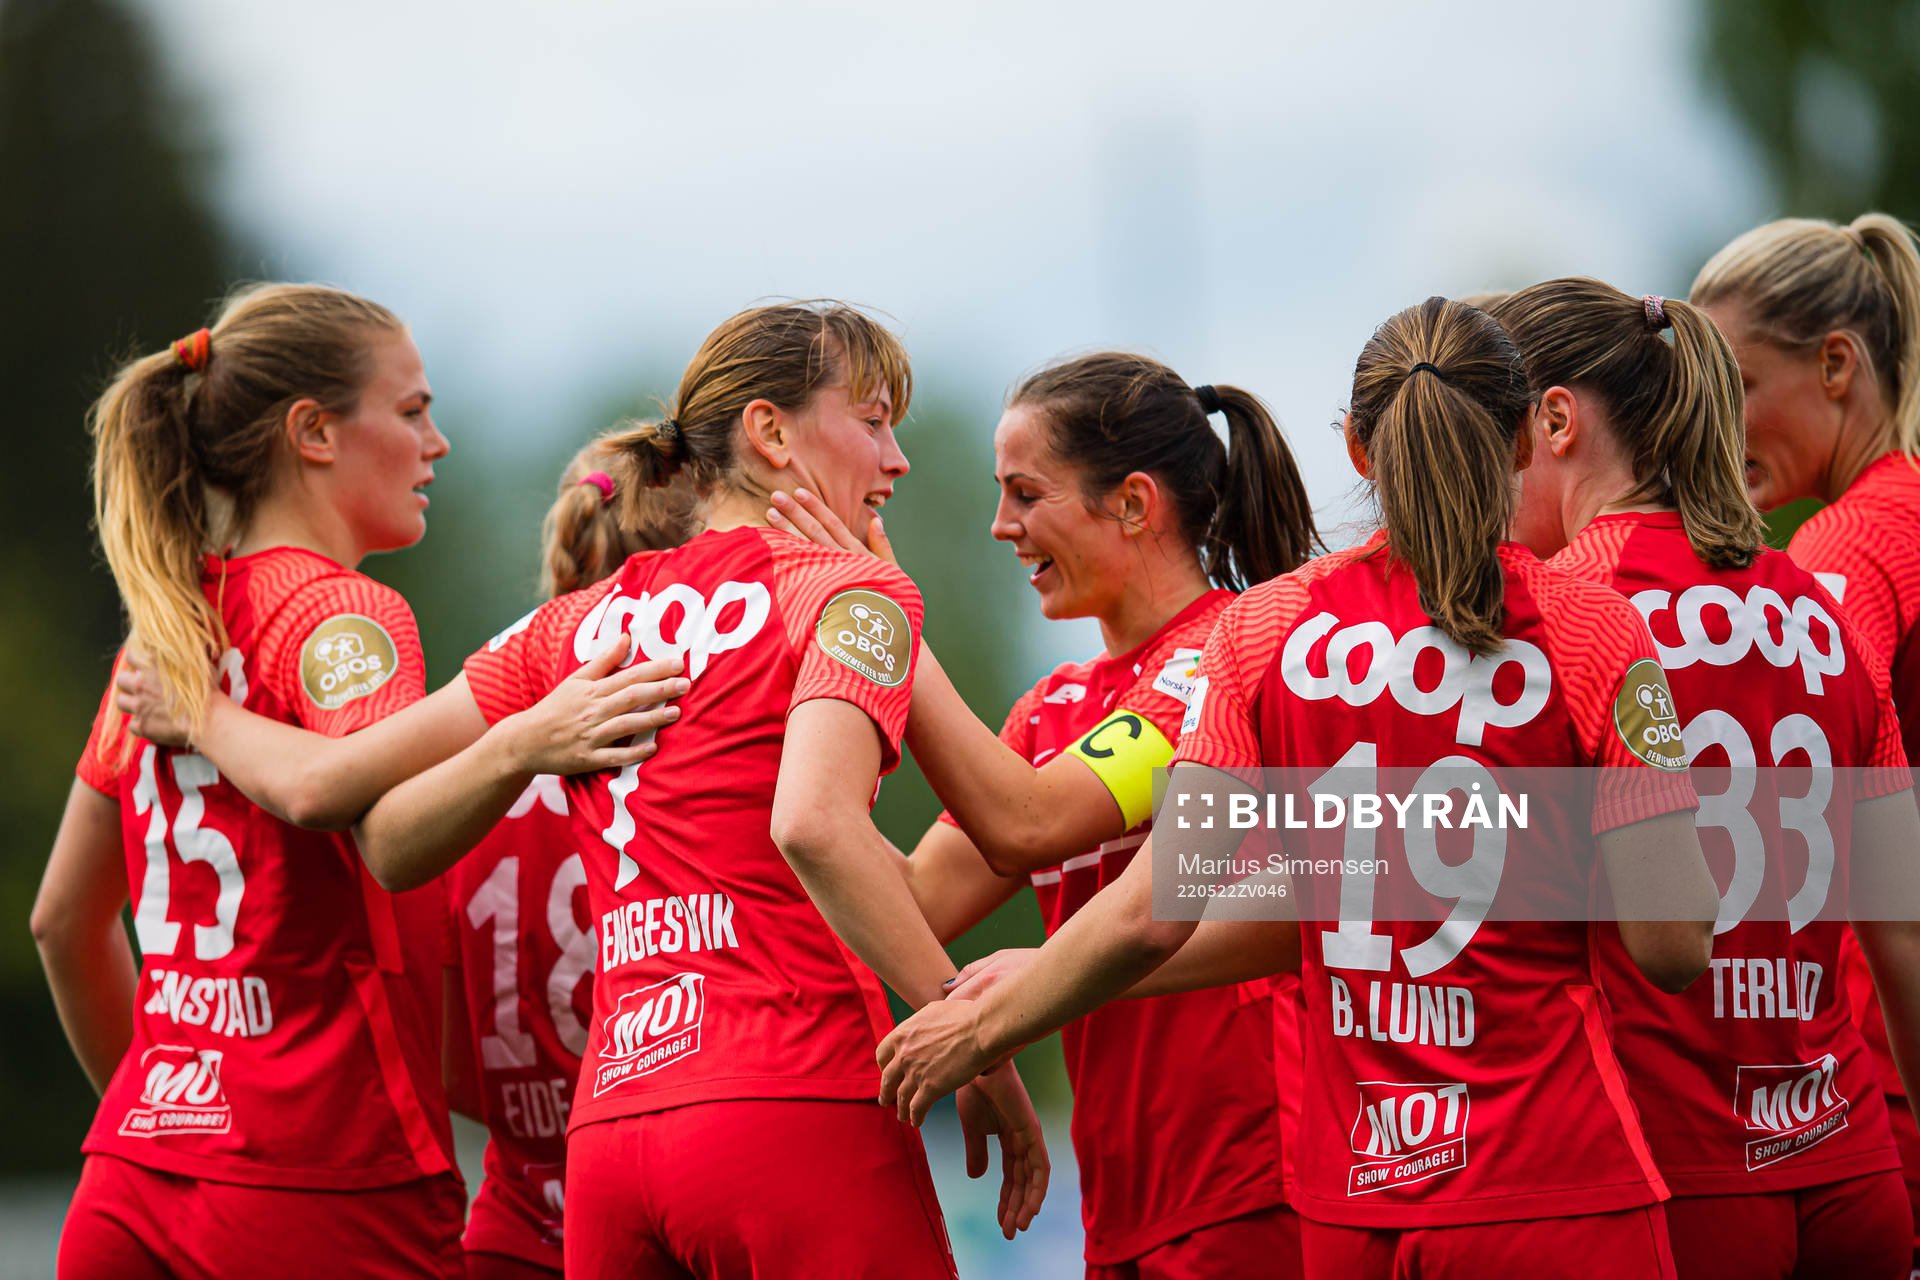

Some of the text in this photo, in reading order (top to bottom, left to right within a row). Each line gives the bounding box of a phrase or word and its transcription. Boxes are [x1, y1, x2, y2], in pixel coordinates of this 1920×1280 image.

[320, 654, 382, 692] OBOS
[838, 630, 895, 672] OBOS
[1632, 585, 1846, 696] coop
[1160, 676, 1184, 693] Norsk
[1281, 611, 1551, 745] coop
[1080, 714, 1142, 759] C
[1642, 722, 1682, 745] OBO
[132, 743, 246, 962] 15
[1678, 709, 1835, 935] 33
[1306, 741, 1508, 979] 19
[602, 893, 739, 973] ENGESVIK
[613, 973, 705, 1058] MOT
[1331, 976, 1475, 1047] B.LUND
[601, 1035, 691, 1086] SHOW COURAGE!
[1751, 1054, 1838, 1131] MOT
[1366, 1083, 1467, 1156] MOT
[1754, 1113, 1843, 1160] SHOW COURAGE!
[1357, 1148, 1456, 1186] SHOW COURAGE!
